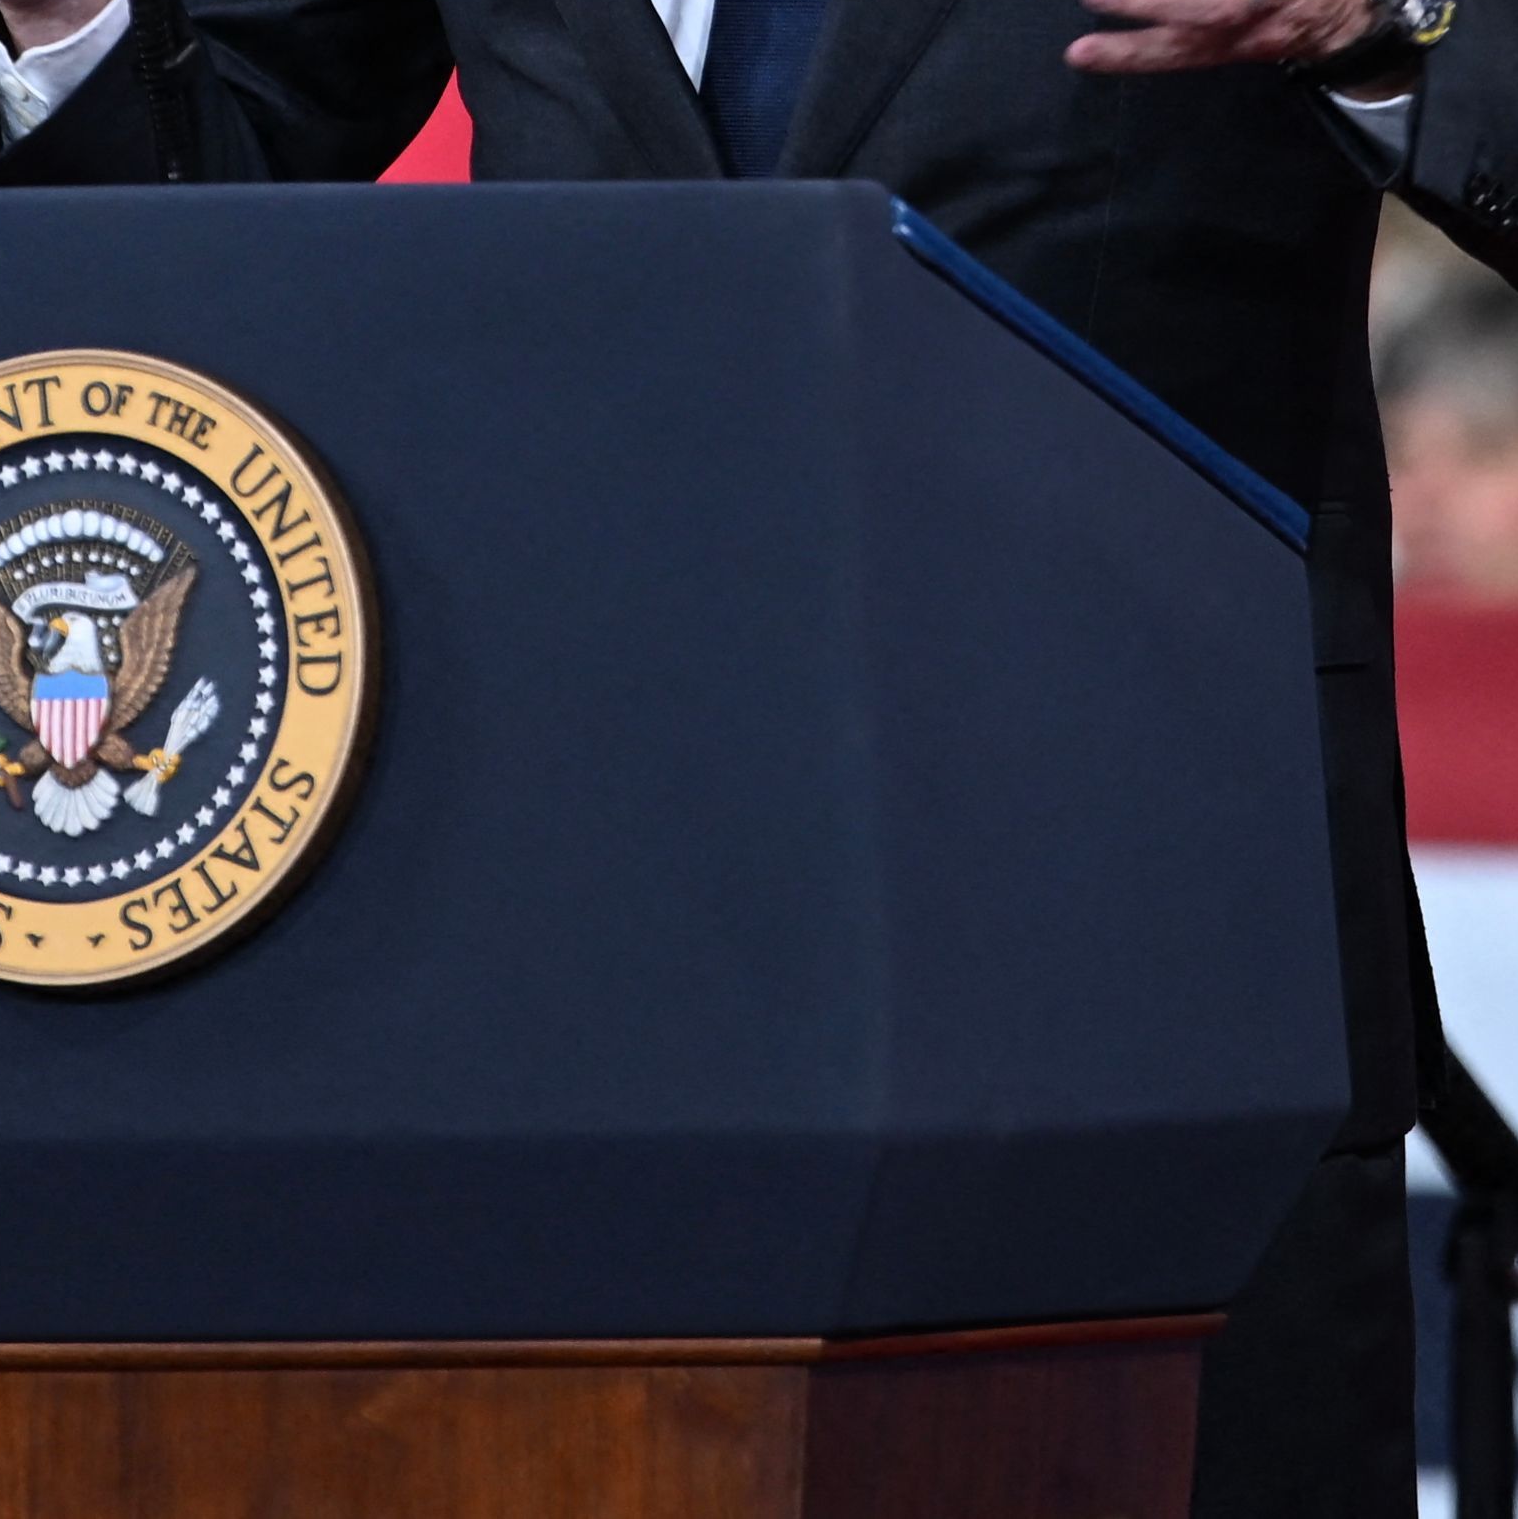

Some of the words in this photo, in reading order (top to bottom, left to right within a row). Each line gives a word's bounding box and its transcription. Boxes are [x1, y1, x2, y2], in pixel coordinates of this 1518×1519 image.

[81, 380, 134, 418] OF
[147, 391, 217, 451] THE
[229, 443, 343, 696] UNITED
[119, 758, 316, 951] STATES
